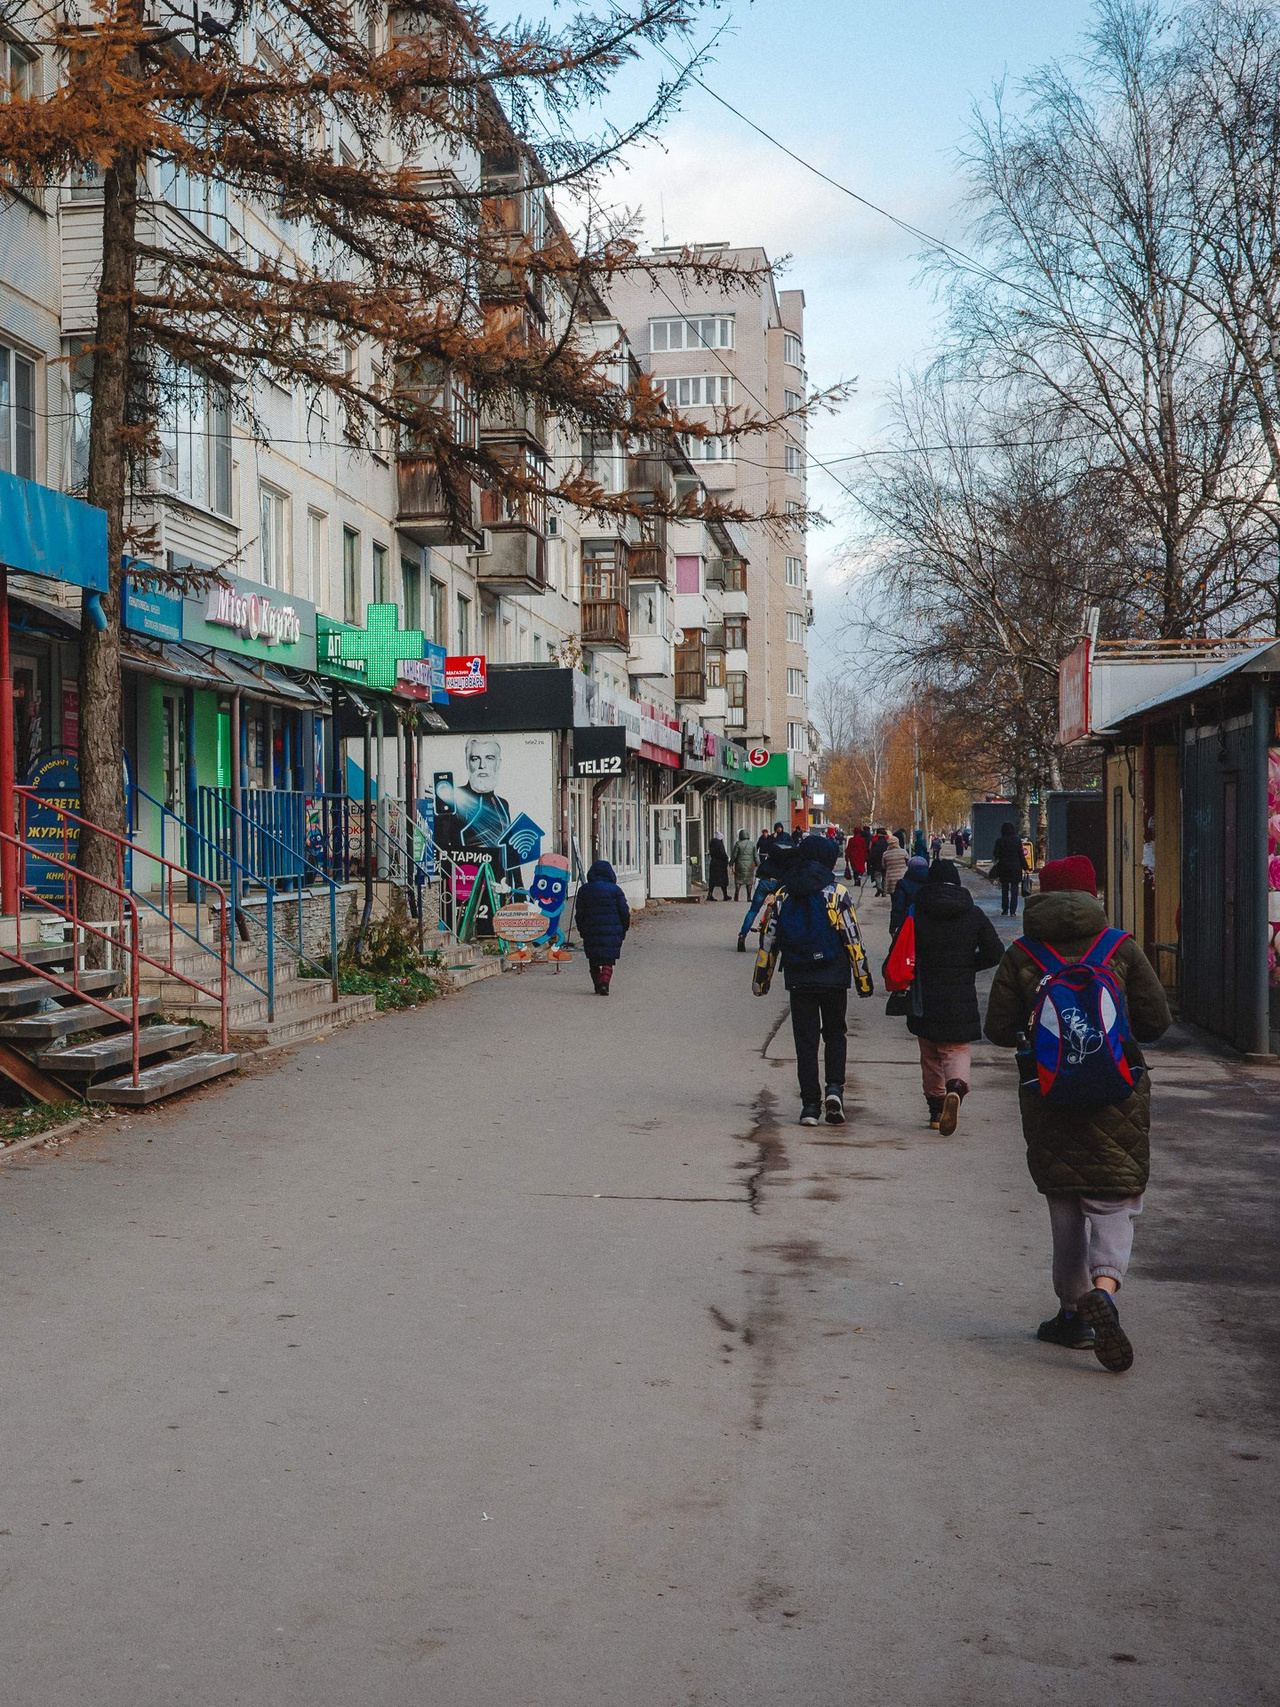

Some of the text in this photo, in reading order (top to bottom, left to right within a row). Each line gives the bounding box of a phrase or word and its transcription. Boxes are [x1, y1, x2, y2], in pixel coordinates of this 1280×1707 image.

[216, 582, 247, 627] Miss
[446, 676, 484, 689] КАНЦТОВАРЫ
[578, 756, 622, 774] TELE2
[451, 850, 493, 865] ТАРИФ
